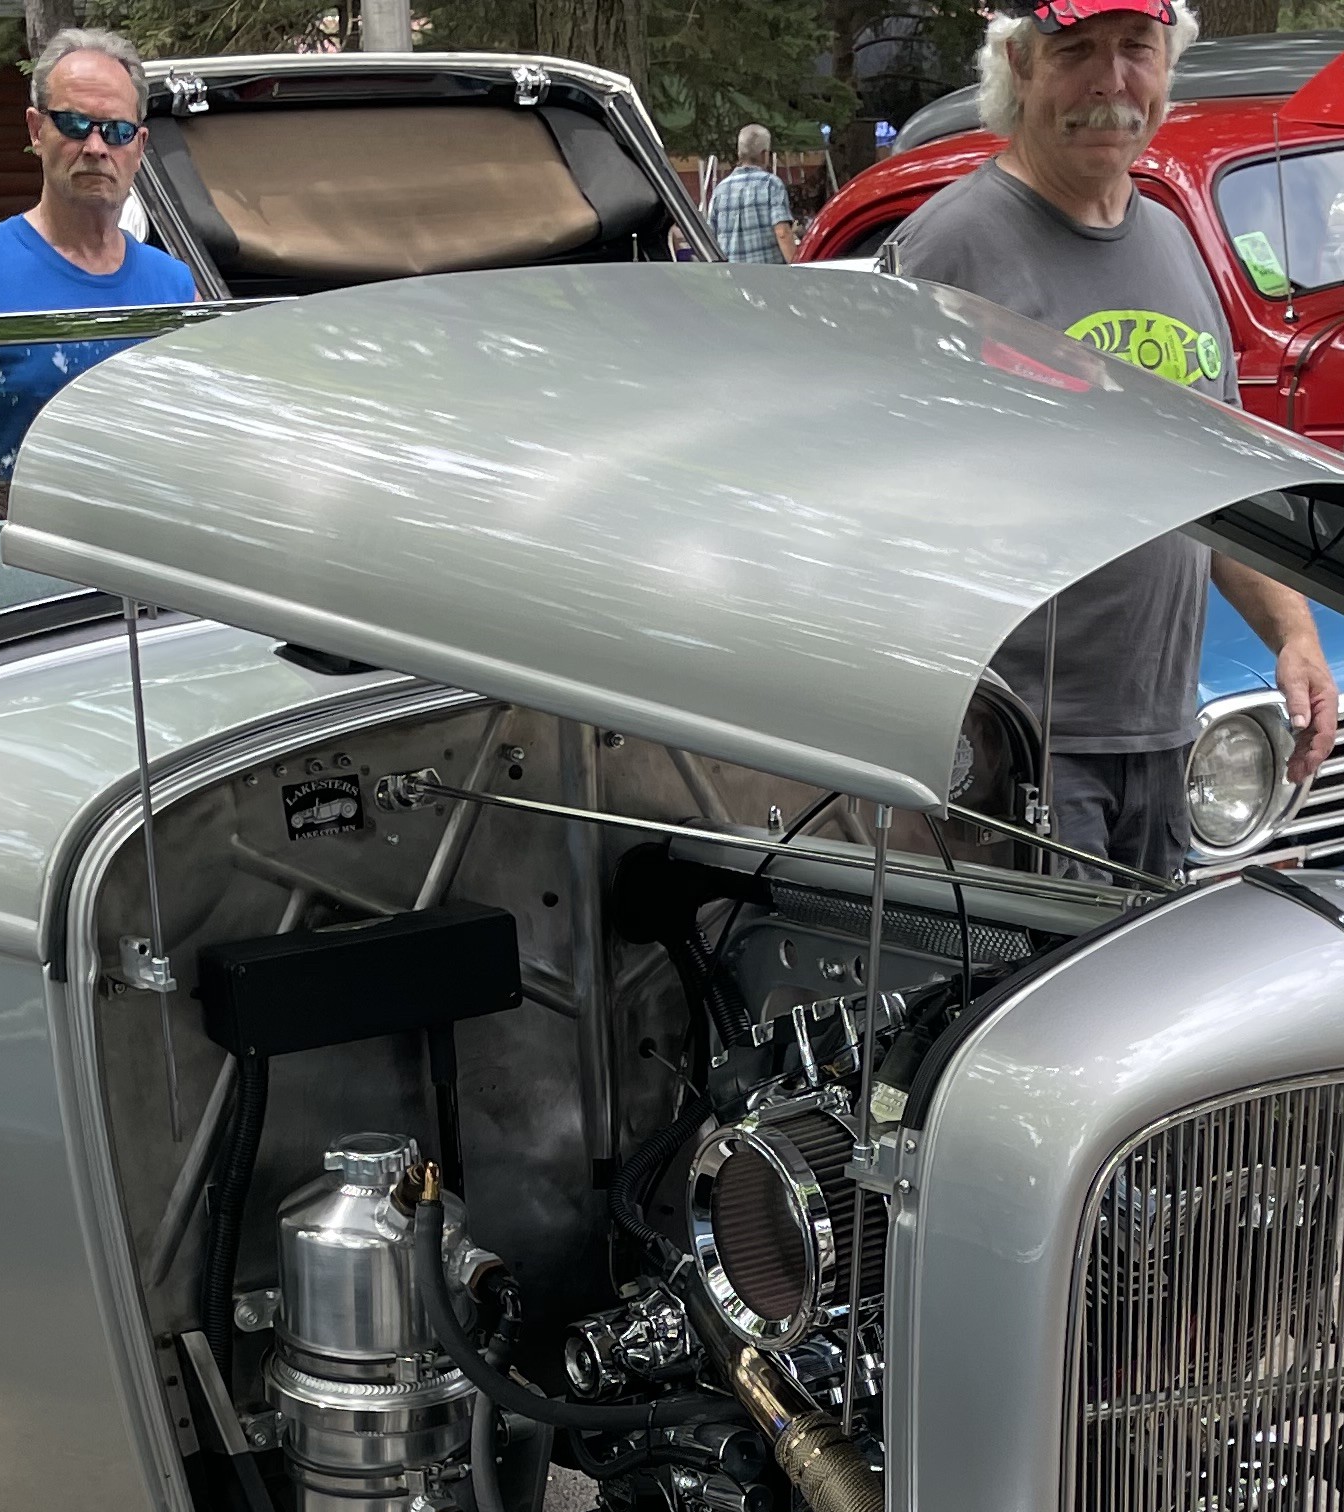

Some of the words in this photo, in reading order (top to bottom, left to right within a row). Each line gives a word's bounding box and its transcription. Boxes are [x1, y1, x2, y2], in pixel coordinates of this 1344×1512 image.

[285, 779, 360, 807] LAKESTERS
[295, 829, 319, 841] LAKE
[319, 827, 340, 837] CITY
[342, 824, 356, 833] MN
